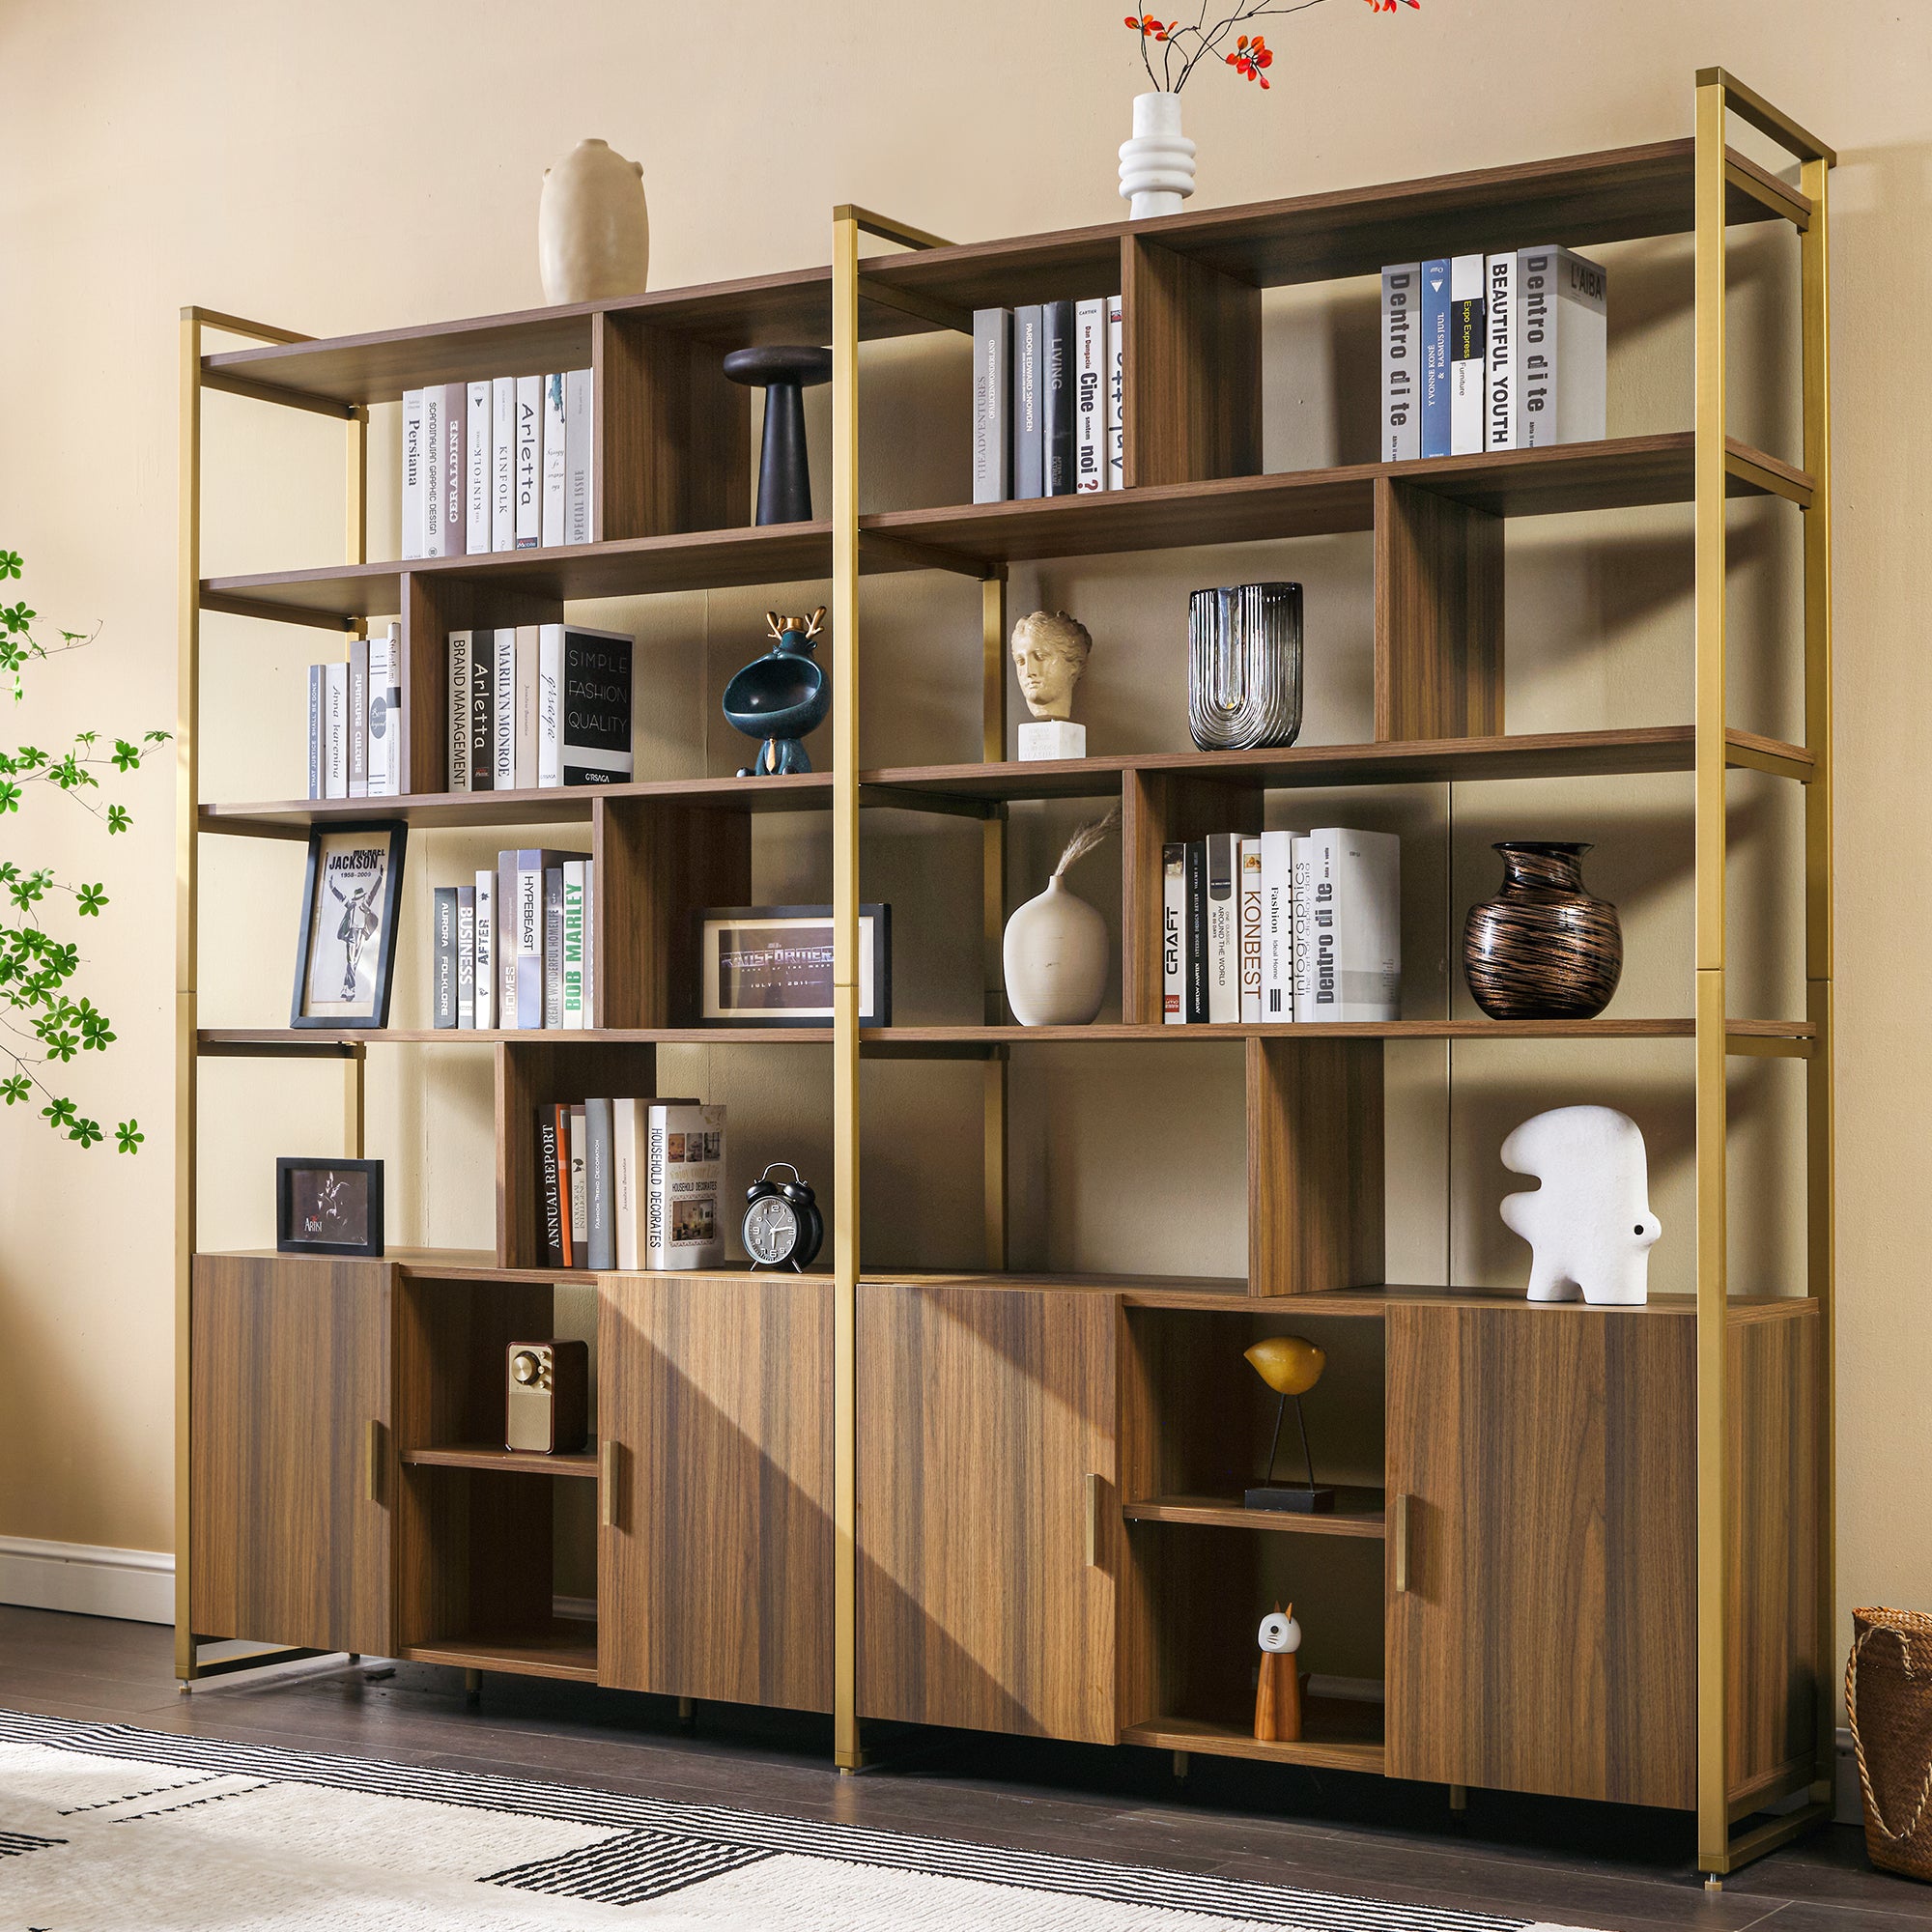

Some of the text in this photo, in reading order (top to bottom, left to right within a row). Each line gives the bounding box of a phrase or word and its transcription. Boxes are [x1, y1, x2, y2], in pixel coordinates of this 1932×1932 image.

[1051, 338, 1063, 390] LIVING
[1390, 274, 1410, 426] Dentro di te
[1492, 264, 1508, 443] BEAUTIFUL YOUTH
[1527, 256, 1548, 412] Dentro di te
[1080, 372, 1097, 412] Cine
[408, 419, 421, 486] Persiana
[473, 448, 482, 511] KINFOLK
[499, 445, 508, 514] KINFOLK
[521, 403, 535, 506] Arletta
[1081, 445, 1097, 473] noi
[574, 469, 584, 541] SPECIAL ISSUE
[569, 650, 627, 673] SIMPLE
[569, 680, 627, 704] FASHION
[312, 703, 317, 713] BE
[453, 639, 466, 786] BRAND MANAGEMENT
[474, 663, 490, 749] Arletta
[497, 644, 511, 778] MARILYN MONROE
[568, 711, 627, 734] QUALITY
[329, 855, 378, 869] JACKSON
[460, 907, 473, 985] BUSINESS
[525, 876, 534, 951] HYPEBEAST
[565, 883, 582, 1010] BOB MARLEY
[1167, 906, 1179, 975] CRAFT
[1243, 891, 1262, 1000] KONBEST
[1270, 887, 1279, 934] Fashion
[1293, 863, 1307, 996] infographics
[1315, 883, 1334, 1004] Dentro di te
[440, 902, 449, 1016] AURORA FOLKLORE
[505, 966, 516, 1015] HOMES
[548, 910, 559, 1025] CREATE WONDERFUL HOMELIFE
[542, 1124, 560, 1249] ANNUAL REPORT
[650, 1128, 663, 1248] HOUSEHOLD DECORATES
[672, 1182, 695, 1192] HOUSEHOLD
